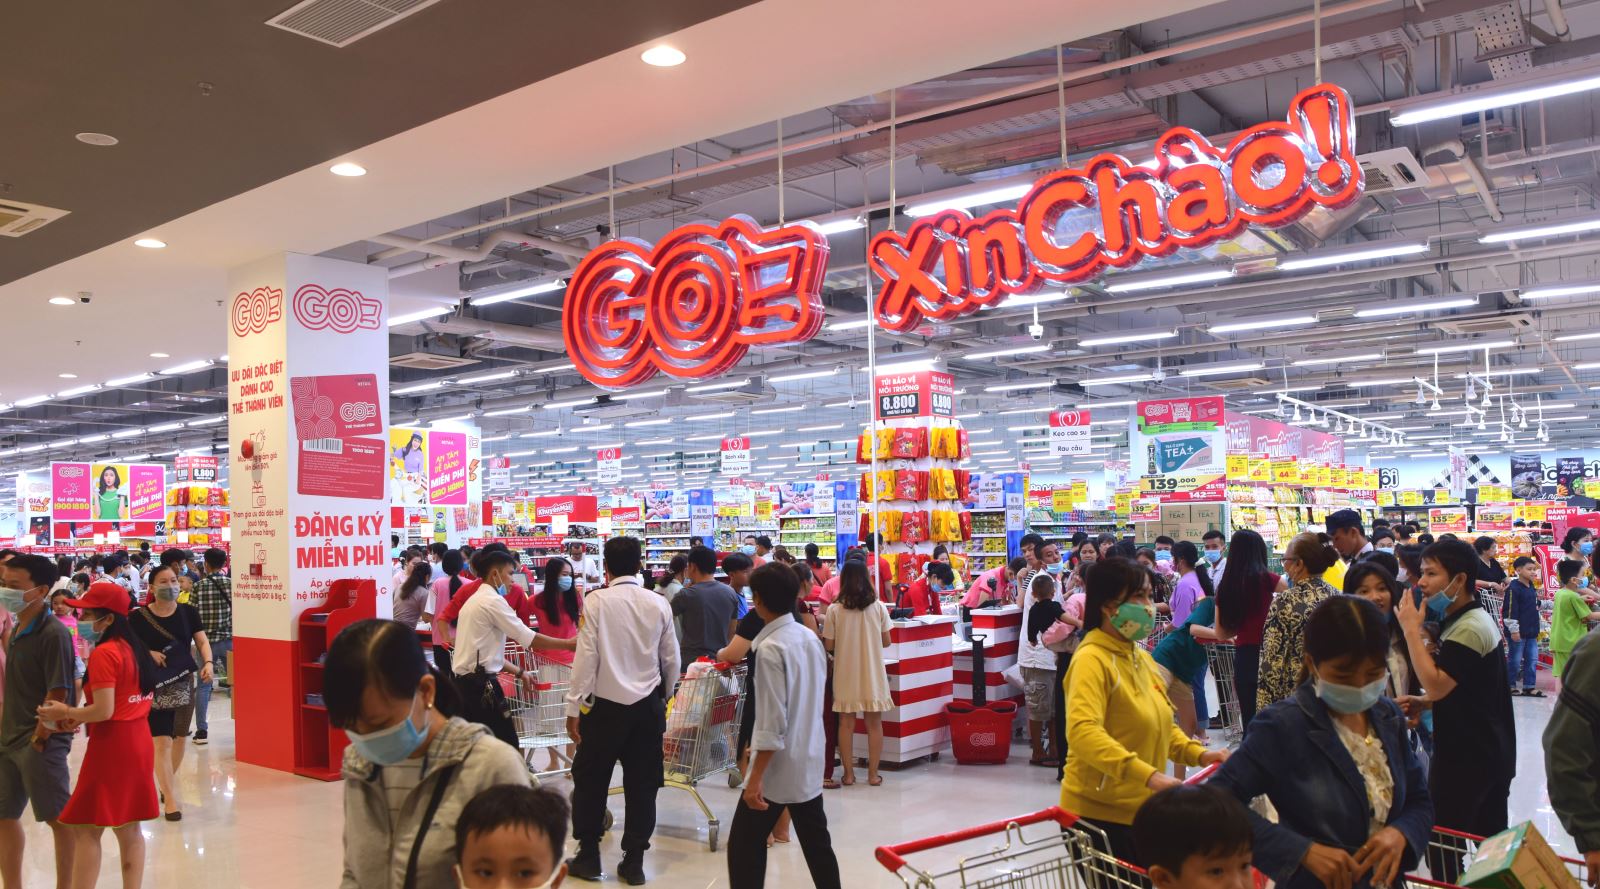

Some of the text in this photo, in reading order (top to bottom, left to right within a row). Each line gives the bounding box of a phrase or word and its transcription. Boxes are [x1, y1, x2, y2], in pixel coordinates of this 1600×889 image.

[882, 394, 916, 410] 8.800
[933, 394, 951, 410] 8.800
[430, 467, 465, 488] MIỄN PHÍ
[294, 510, 384, 537] ĐĂNG KÝ
[296, 538, 384, 568] MIỄN PHÍ
